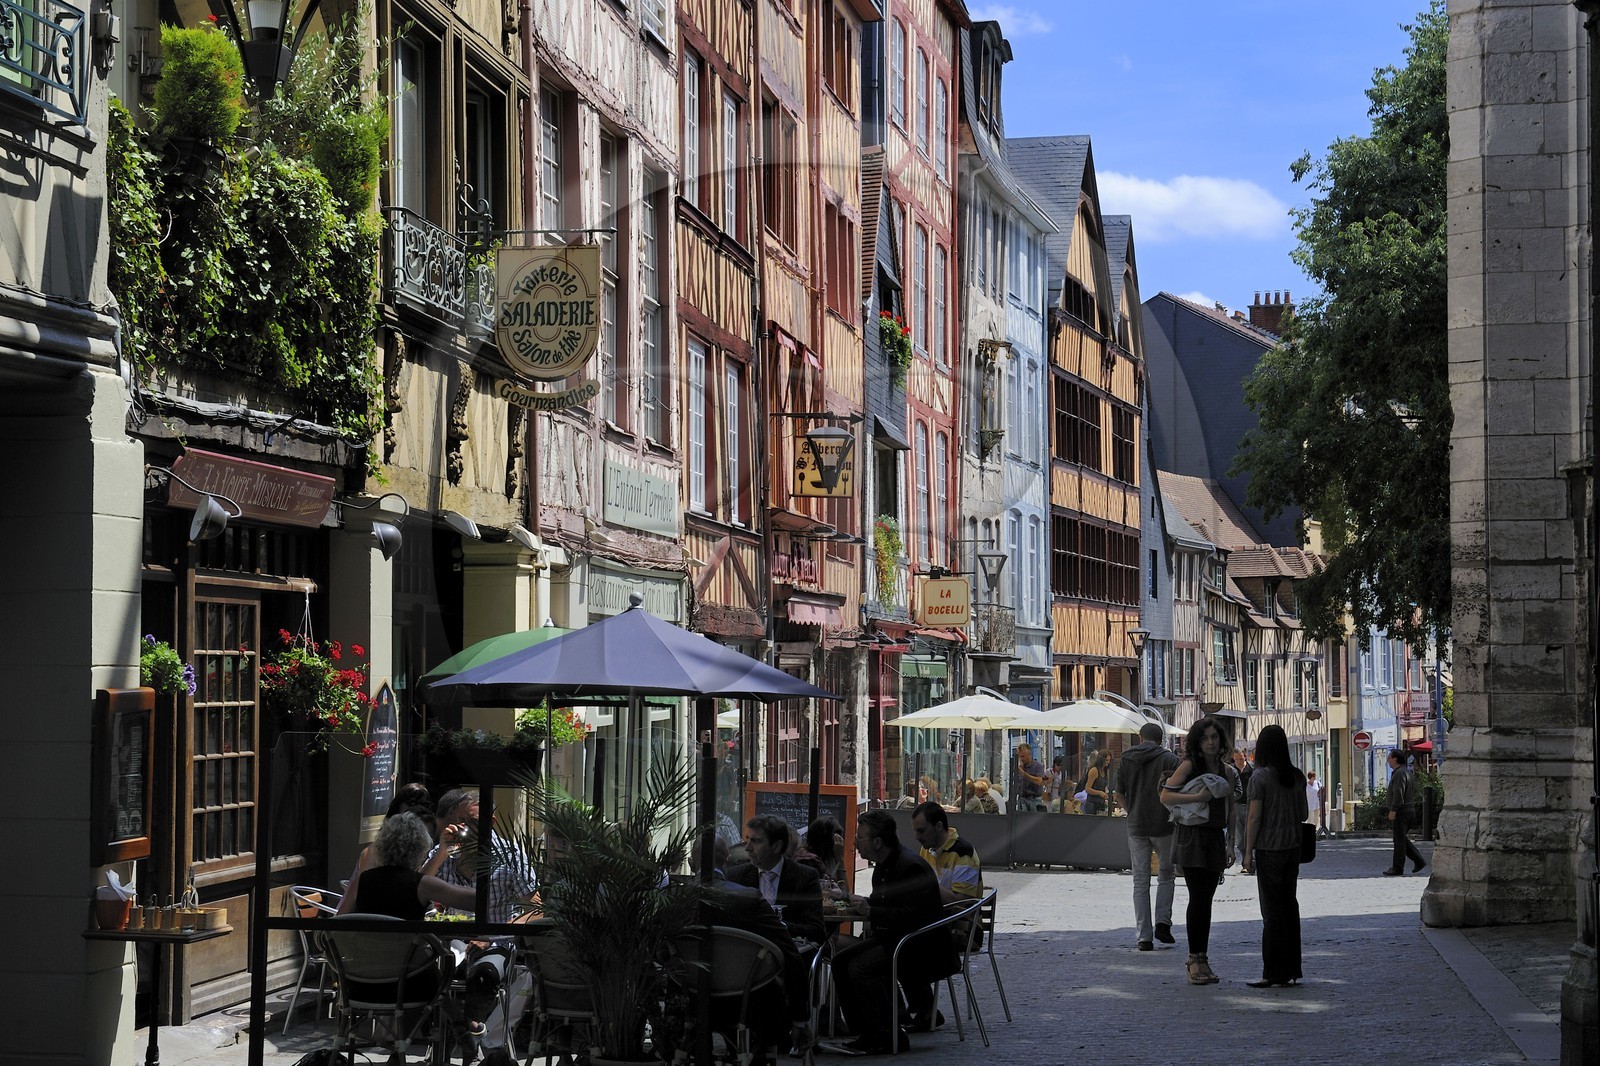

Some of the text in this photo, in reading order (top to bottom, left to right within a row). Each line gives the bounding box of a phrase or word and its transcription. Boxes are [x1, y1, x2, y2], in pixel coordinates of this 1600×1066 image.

[513, 264, 578, 296] Tarterie
[501, 300, 595, 327] SALADERIE
[513, 329, 551, 365] Salon
[552, 349, 564, 364] de
[500, 383, 596, 410] Gourmandine
[608, 466, 674, 522] L'Enfant Terrible
[940, 589, 952, 598] LA
[928, 605, 964, 615] BOCELLI
